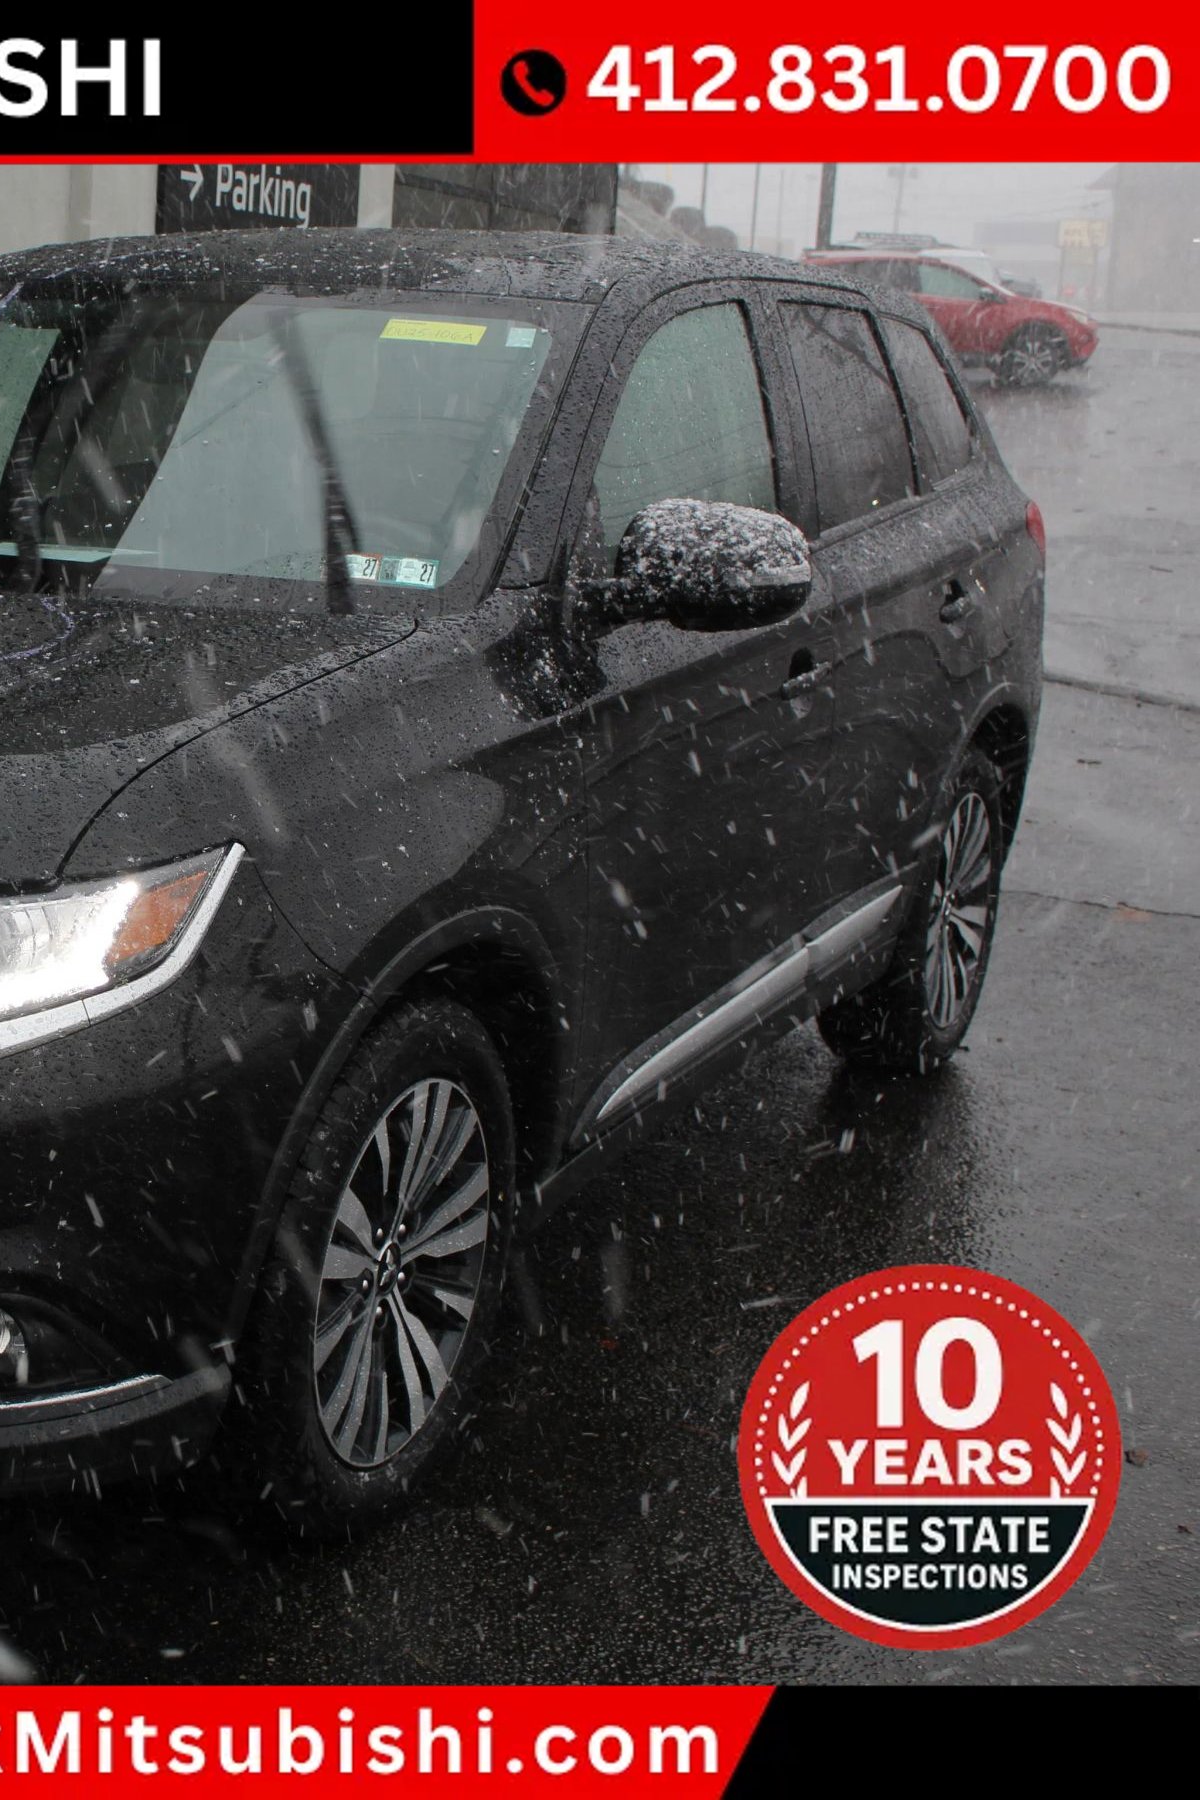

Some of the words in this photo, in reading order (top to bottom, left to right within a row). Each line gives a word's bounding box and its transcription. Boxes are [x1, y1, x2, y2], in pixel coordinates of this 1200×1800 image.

[215, 164, 312, 228] Parking
[363, 559, 378, 578] 27
[420, 563, 435, 583] 27
